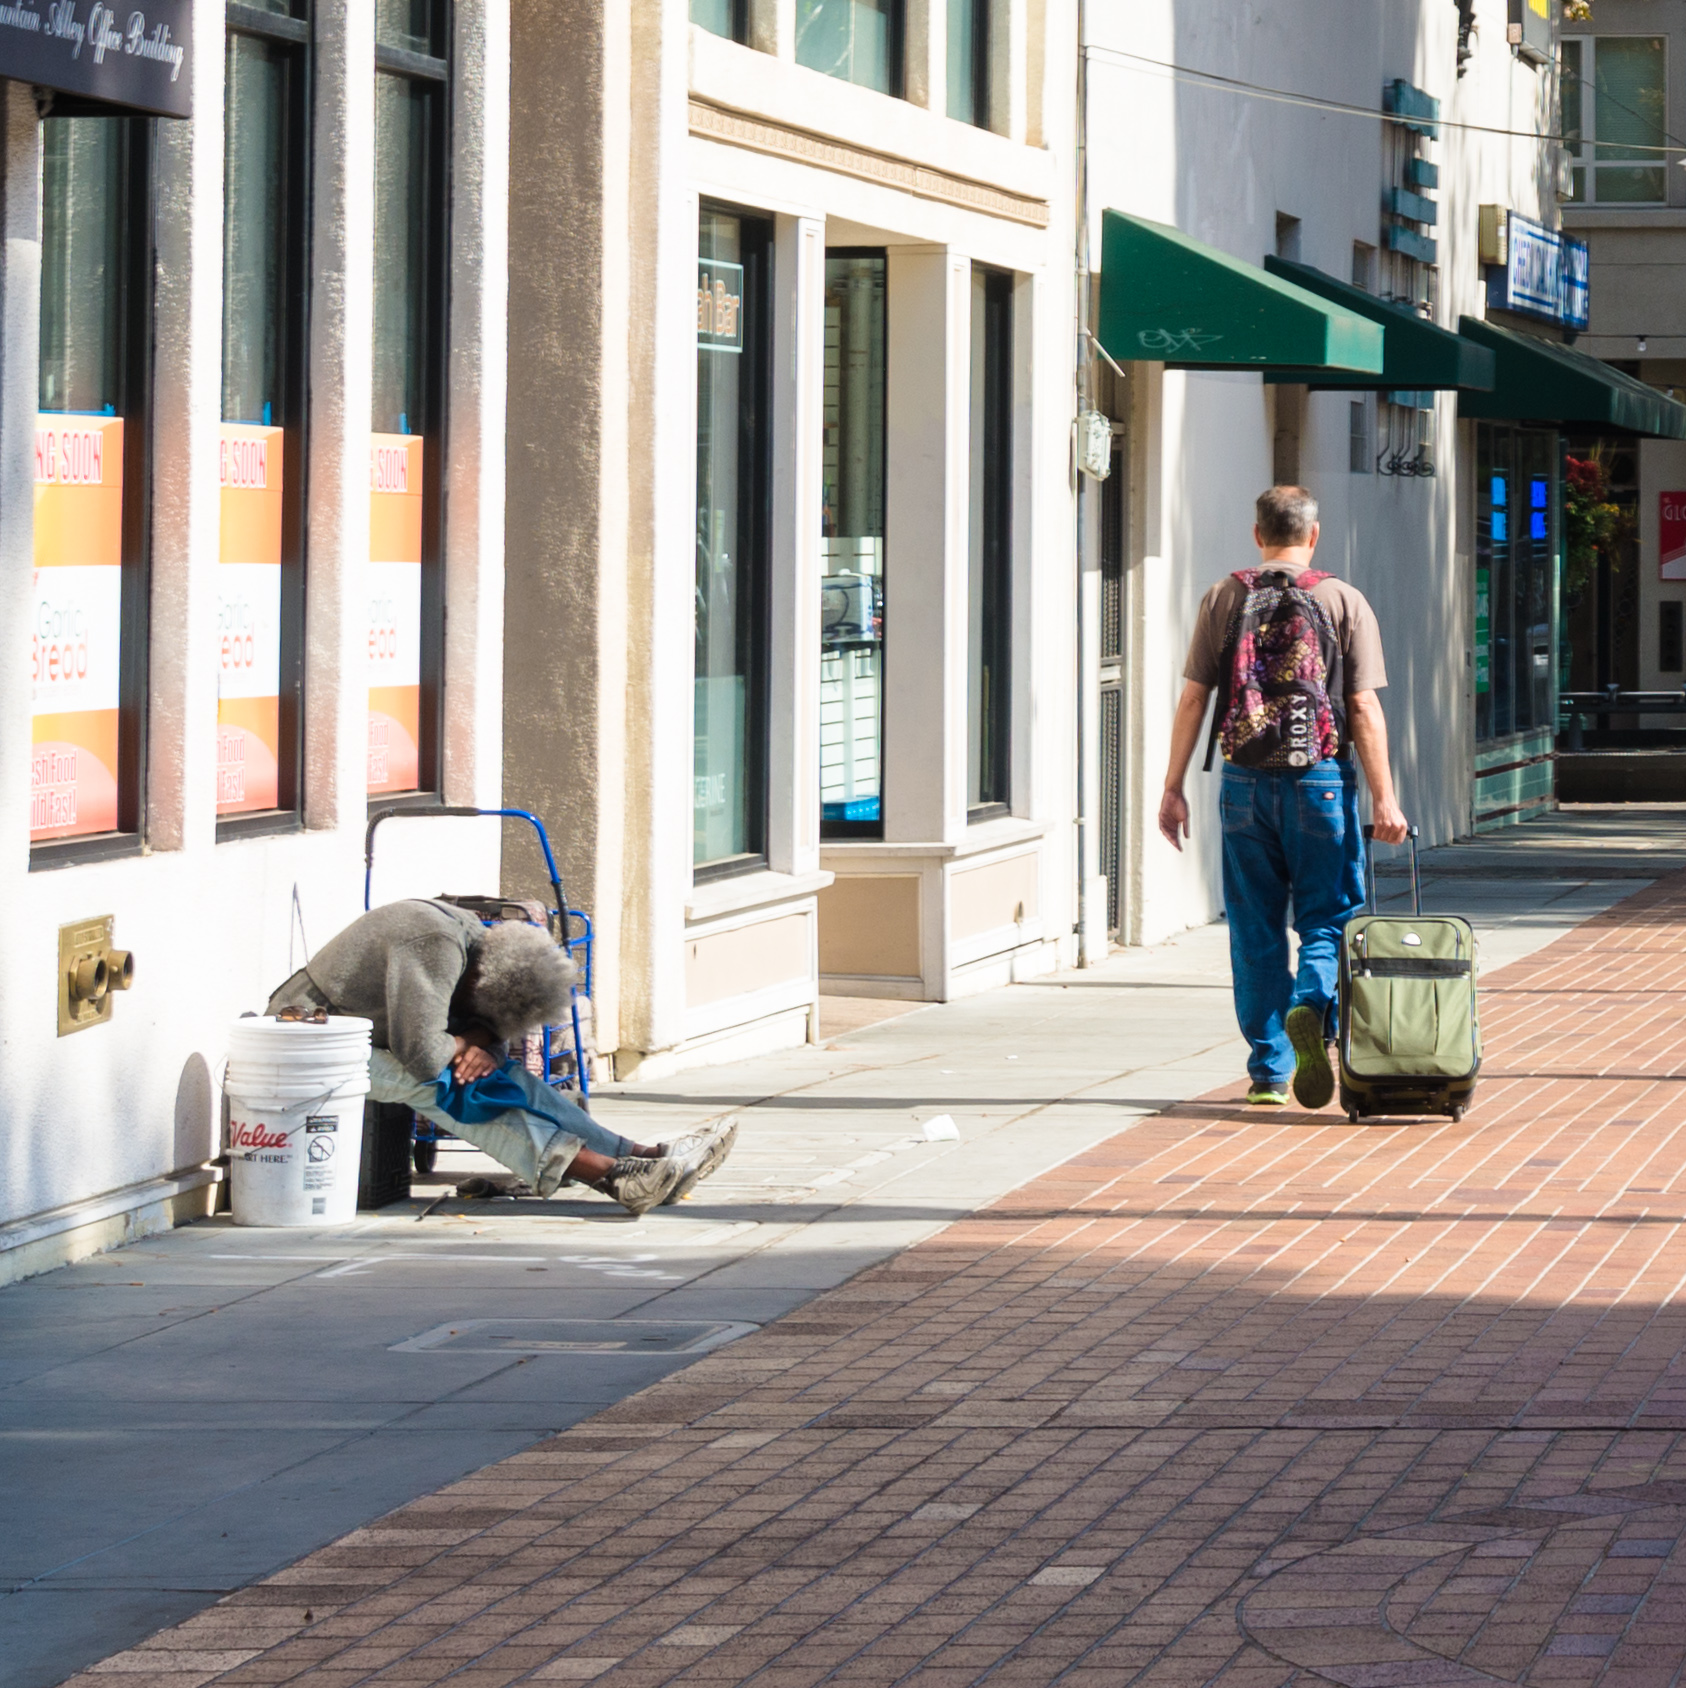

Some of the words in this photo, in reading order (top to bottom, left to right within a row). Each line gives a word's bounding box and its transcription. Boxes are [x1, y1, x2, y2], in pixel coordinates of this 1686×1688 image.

[88, 1, 123, 64] Office
[125, 11, 184, 82] Building
[61, 430, 103, 482] SOON
[232, 439, 267, 488] SOON
[377, 447, 408, 491] SOON
[39, 599, 84, 639] Garlic
[1289, 694, 1308, 748] ROXY
[51, 749, 77, 784] Food
[50, 787, 77, 826] Fast!
[230, 1120, 288, 1148] Value
